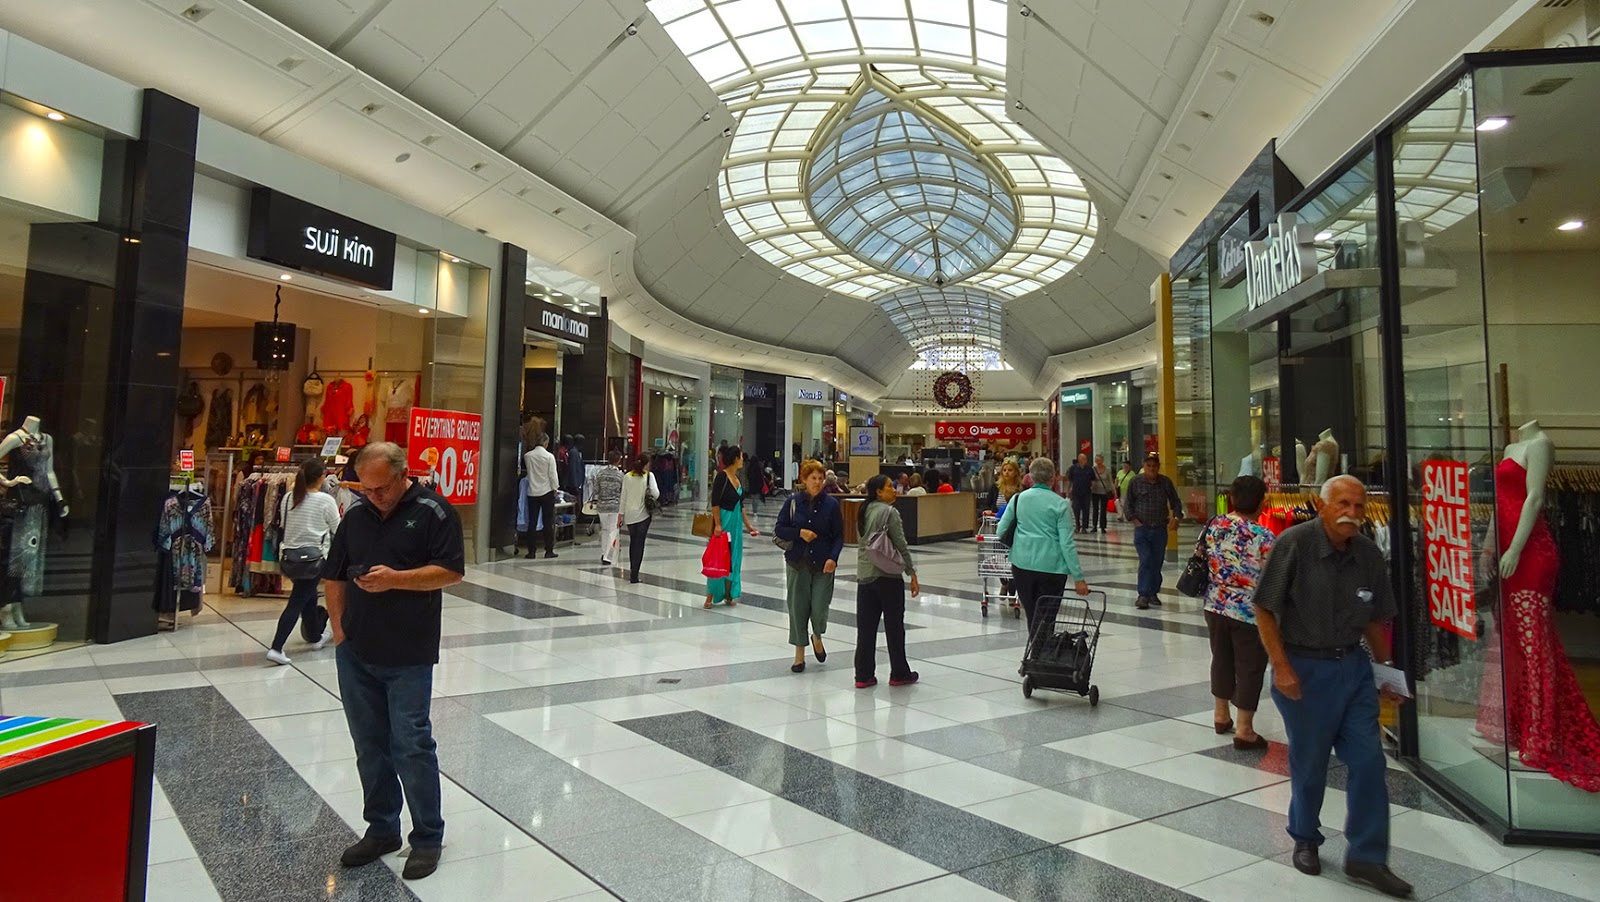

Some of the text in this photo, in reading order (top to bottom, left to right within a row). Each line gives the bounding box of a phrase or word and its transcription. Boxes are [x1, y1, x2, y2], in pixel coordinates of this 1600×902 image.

[343, 236, 374, 267] kim
[1244, 213, 1301, 312] Danielas
[414, 416, 455, 438] EVERYTHING
[462, 450, 474, 476] %
[1263, 460, 1280, 484] SALE
[456, 479, 474, 497] OFF
[1424, 465, 1466, 505] SALE
[1425, 504, 1467, 547] SALE
[1428, 543, 1470, 590] SALE
[1430, 583, 1473, 633] SALE
